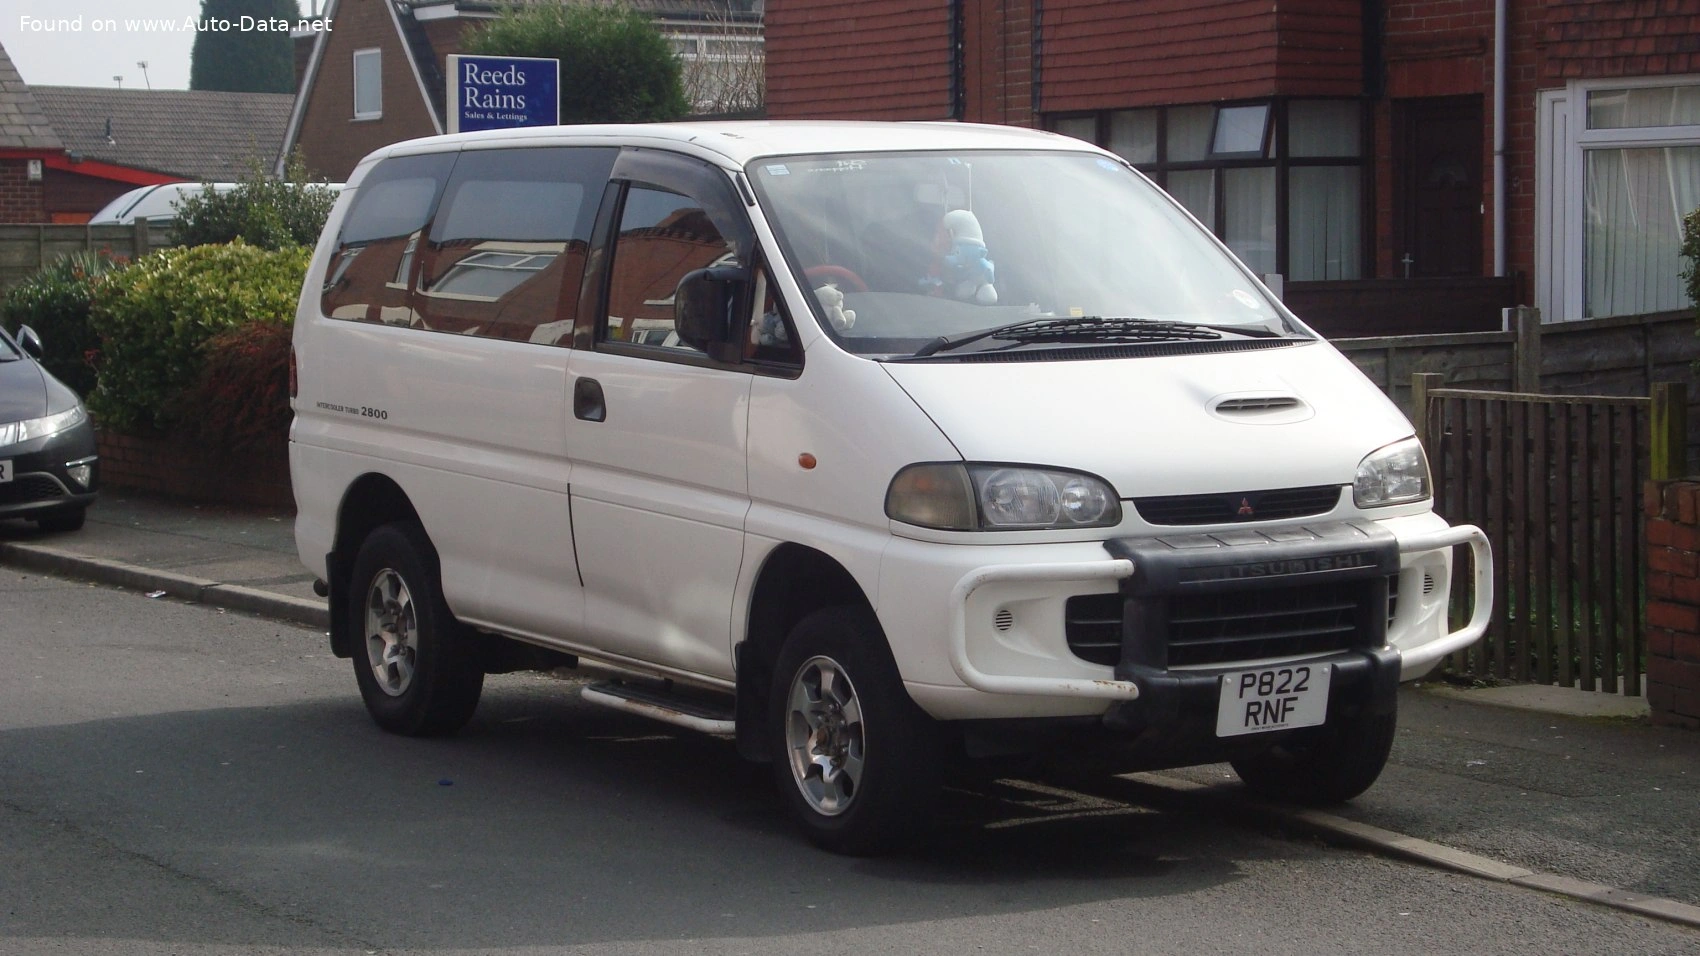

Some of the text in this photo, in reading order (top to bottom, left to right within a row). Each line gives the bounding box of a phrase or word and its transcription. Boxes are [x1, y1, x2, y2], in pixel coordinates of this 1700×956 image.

[464, 63, 525, 86] Reeds
[464, 87, 525, 109] Rains
[465, 111, 484, 119] Sales
[496, 112, 528, 122] Lettings
[361, 406, 388, 420] 2800
[1239, 667, 1311, 699] P822
[1244, 696, 1299, 727] RNF
